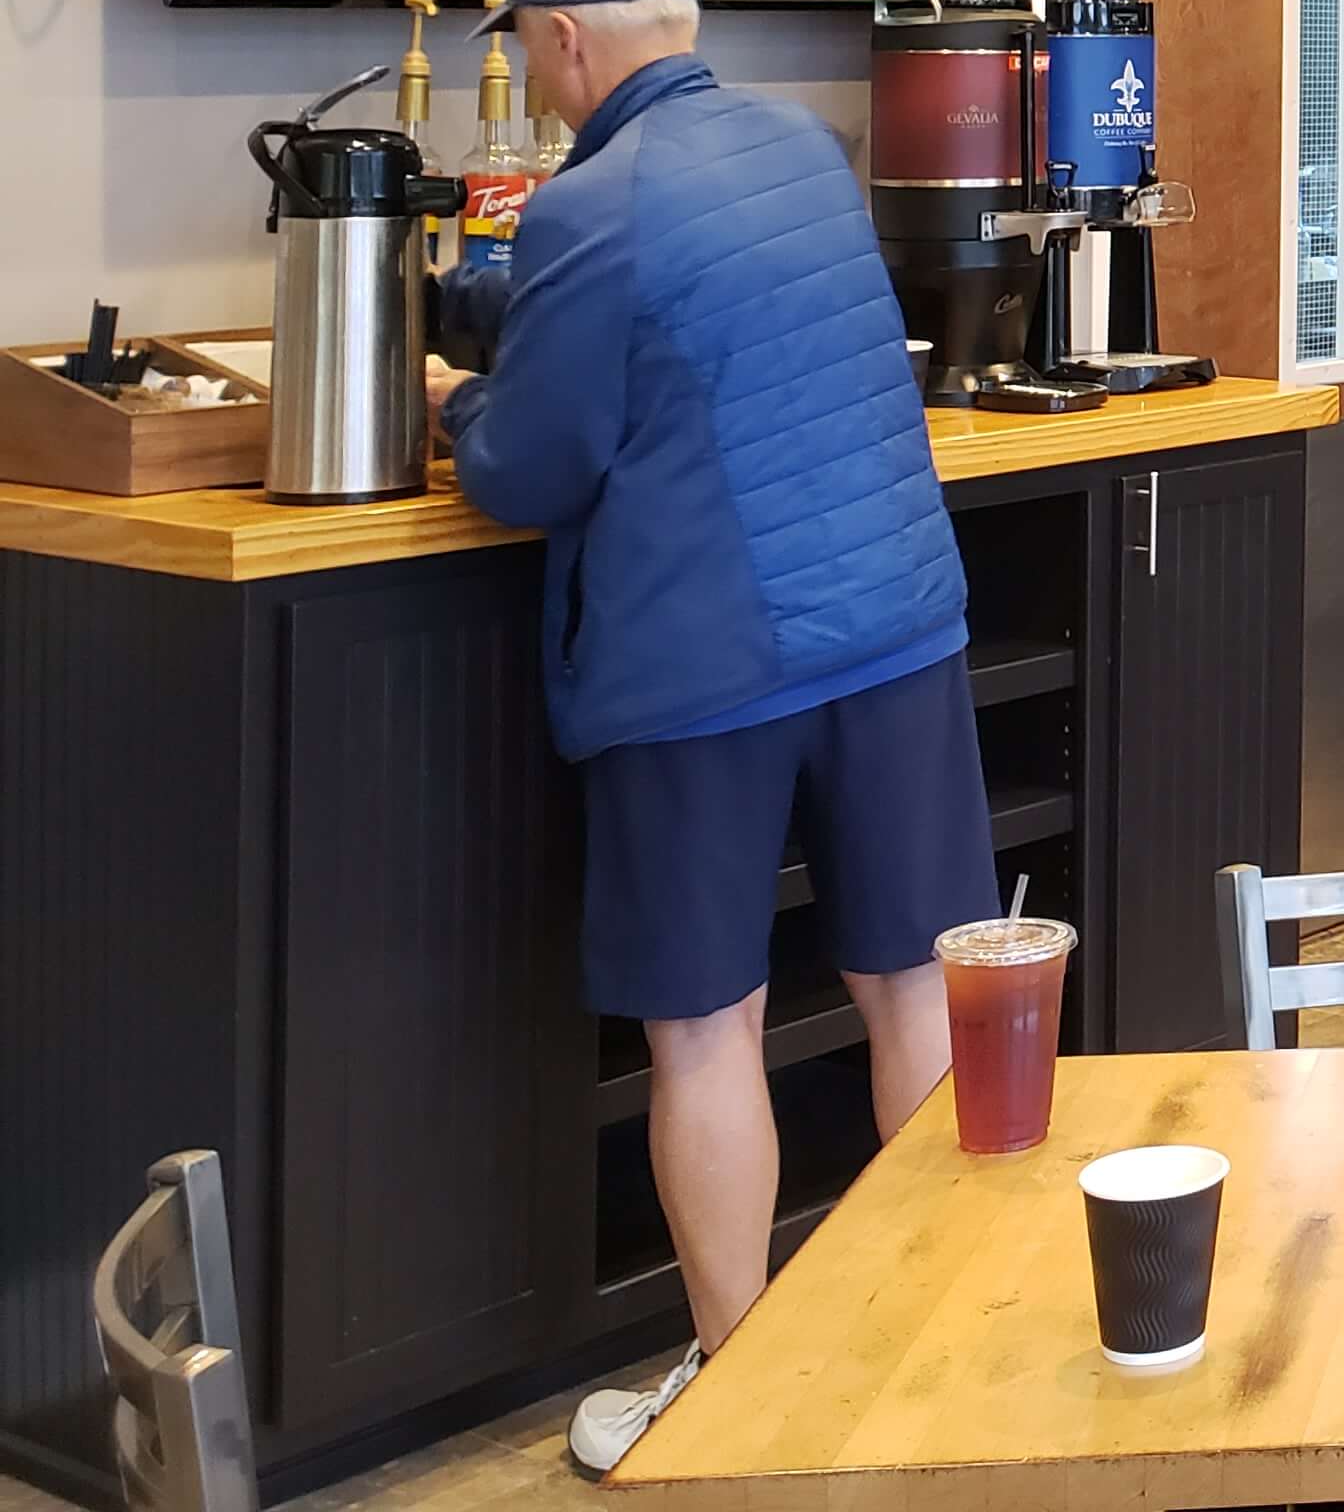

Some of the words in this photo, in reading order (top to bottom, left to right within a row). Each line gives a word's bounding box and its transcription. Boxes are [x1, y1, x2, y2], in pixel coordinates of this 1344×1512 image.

[946, 112, 1000, 125] GEVALIA
[1093, 111, 1153, 128] DUBUQUE
[1094, 128, 1126, 137] COFFEE
